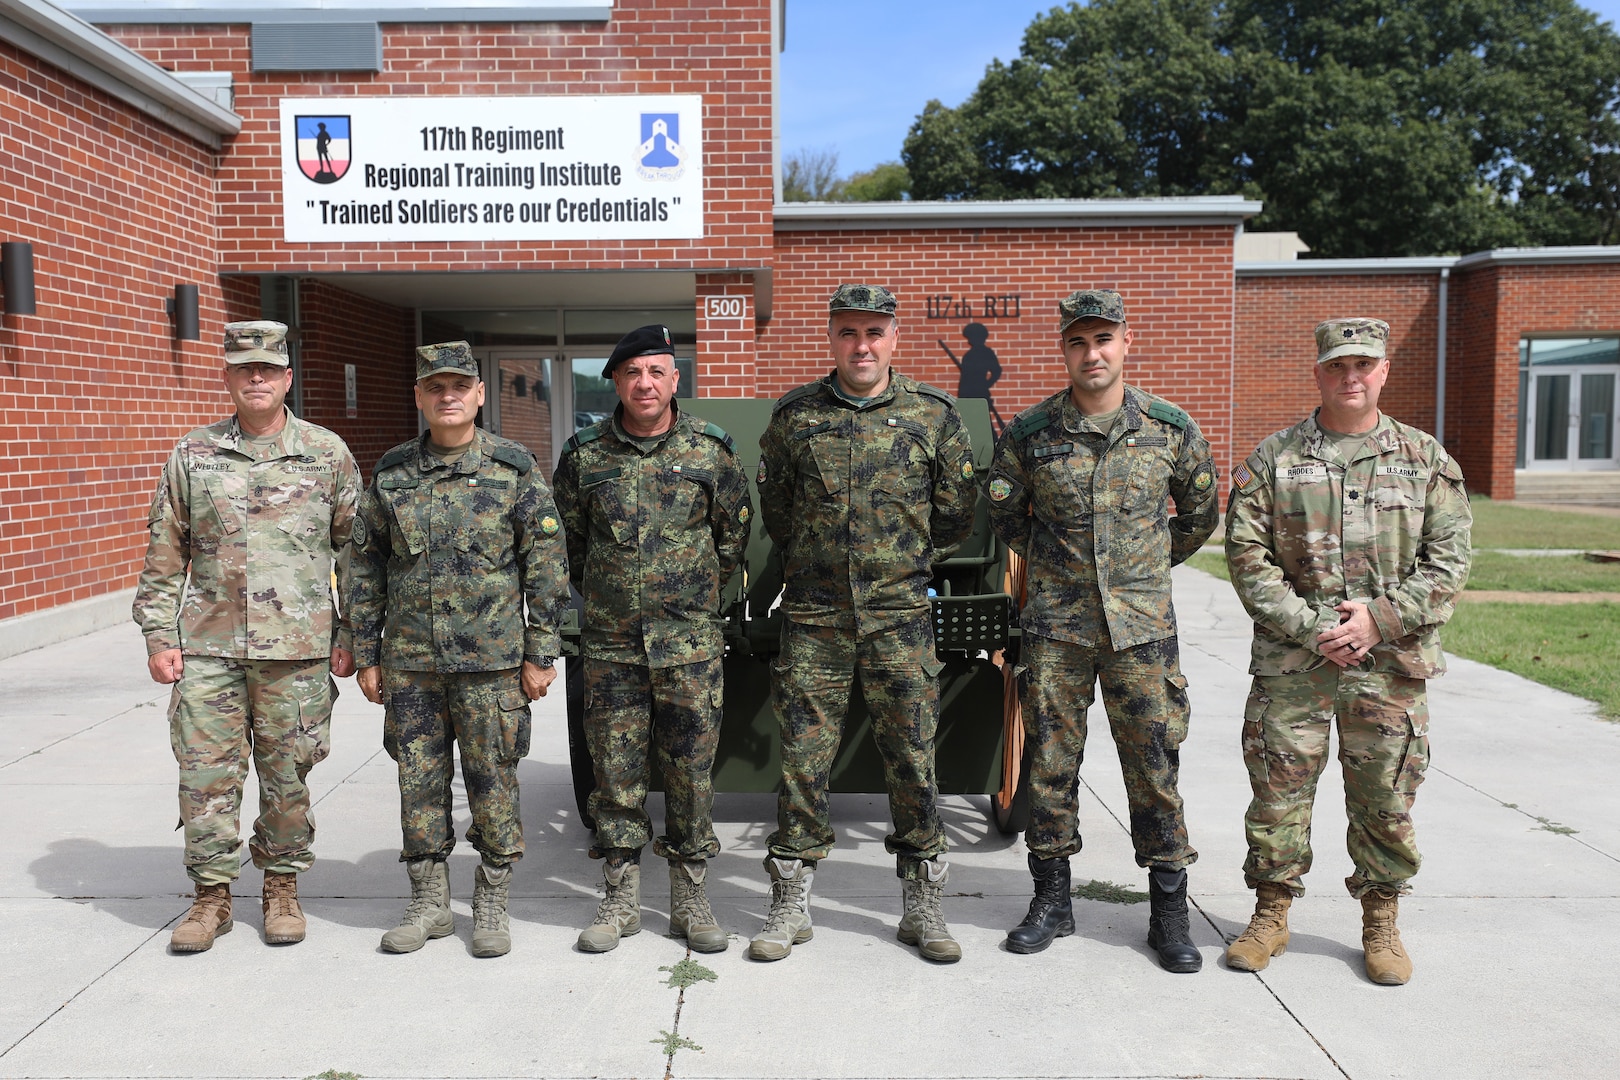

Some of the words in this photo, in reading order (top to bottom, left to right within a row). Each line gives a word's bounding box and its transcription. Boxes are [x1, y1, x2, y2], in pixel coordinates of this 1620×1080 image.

[420, 126, 466, 151] 117th
[471, 126, 564, 154] Regiment
[364, 163, 450, 191] Regional
[454, 162, 535, 190] Training
[540, 162, 622, 187] Institute
[319, 199, 393, 225] Trained
[397, 198, 478, 225] Soldiers
[483, 203, 514, 224] are
[519, 202, 551, 223] our
[556, 197, 668, 223] Credentials
[710, 299, 740, 316] 500
[926, 296, 972, 319] 117th
[984, 295, 1020, 318] RTI
[1287, 467, 1314, 477] RHODES
